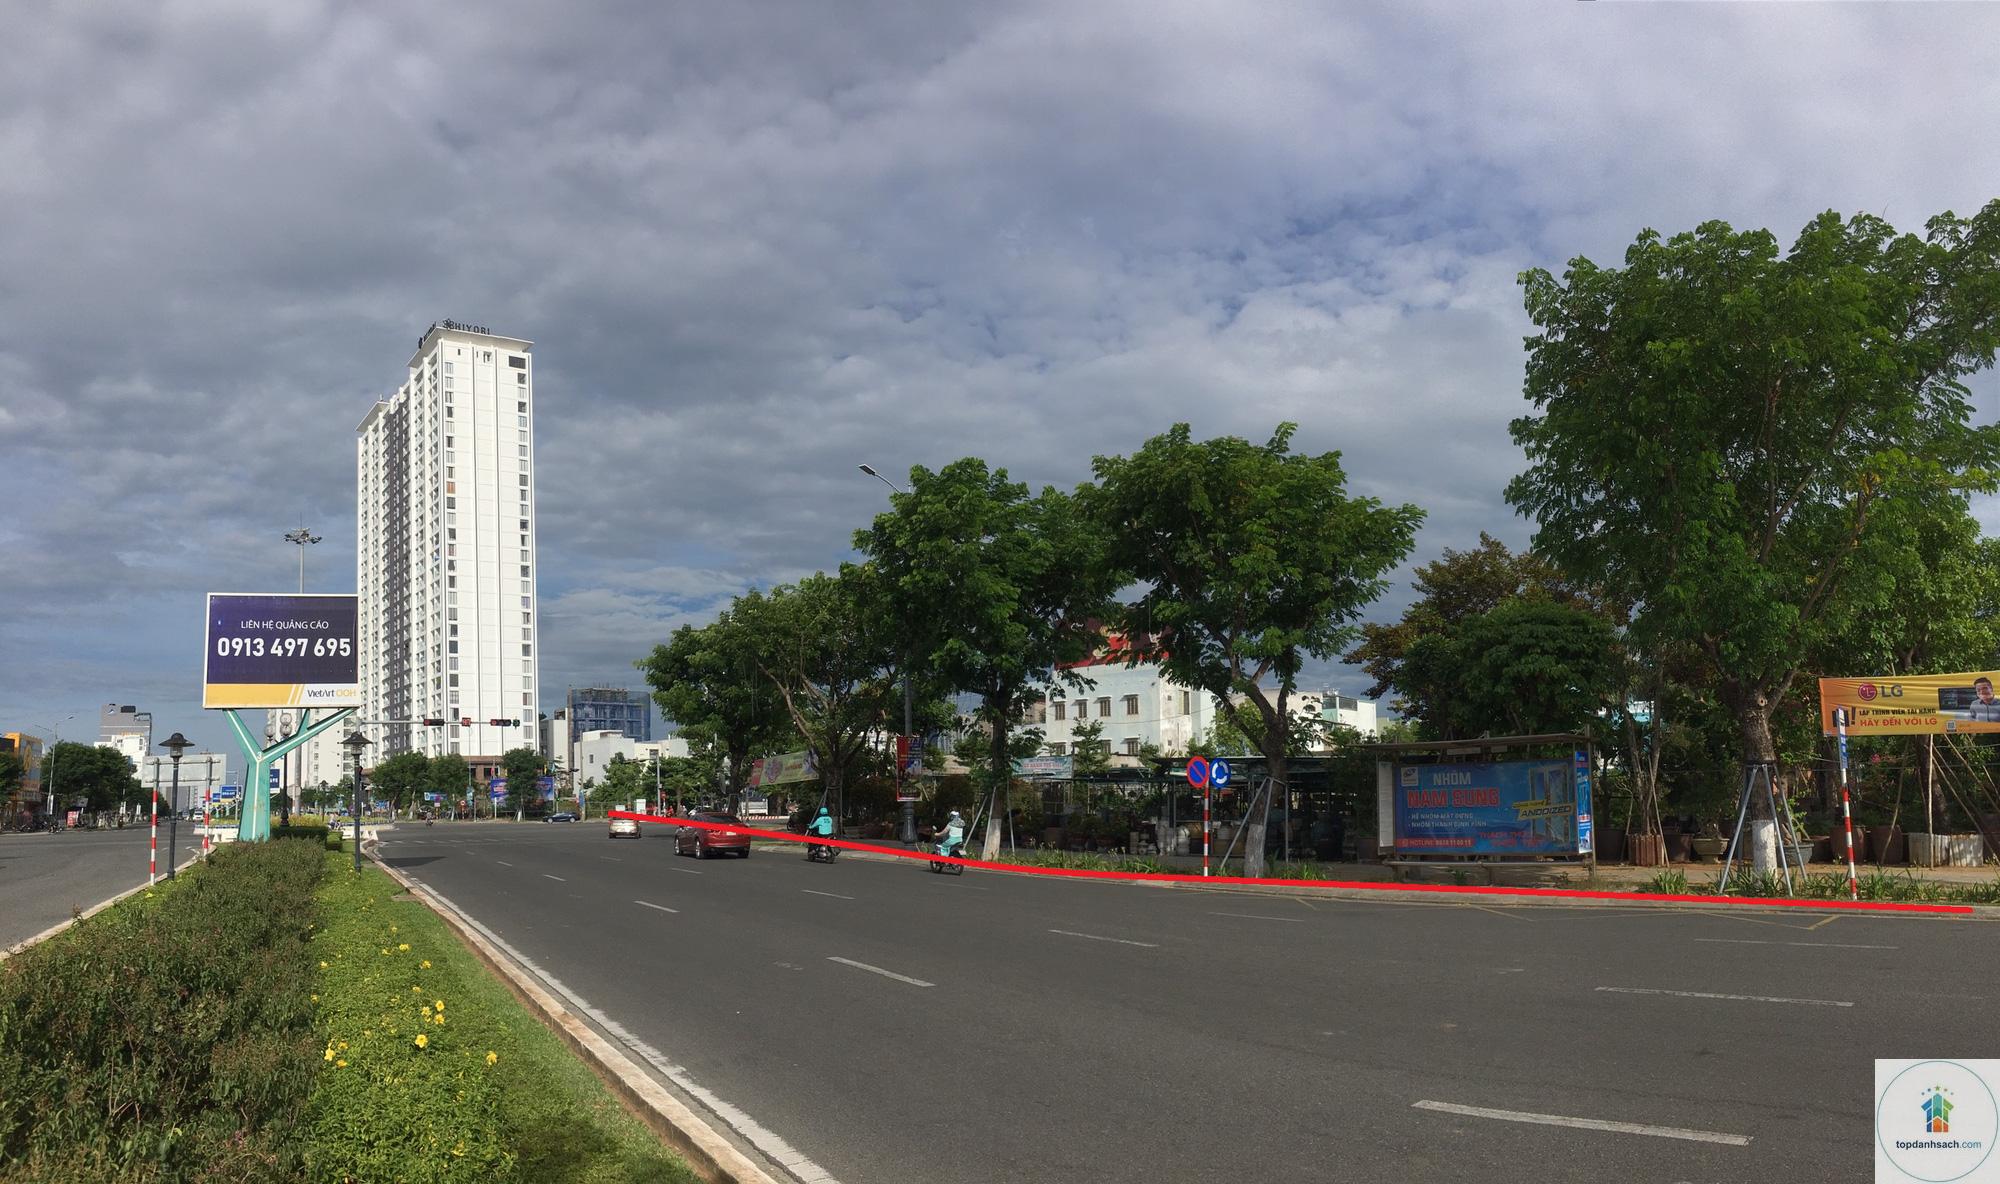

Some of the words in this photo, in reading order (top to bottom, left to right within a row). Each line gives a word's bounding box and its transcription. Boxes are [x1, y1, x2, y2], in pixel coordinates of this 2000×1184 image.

[240, 620, 260, 629] LIÊN
[261, 620, 274, 630] HỆ
[275, 619, 308, 630] QUẢNG
[309, 620, 330, 629] CÁO
[217, 637, 265, 657] 0913
[270, 638, 308, 657] 497
[313, 638, 351, 657] 695
[1881, 685, 1904, 698] LG
[1860, 718, 1879, 726] HÃY
[1882, 715, 1902, 726] ĐẾN
[1904, 716, 1922, 726] VỚI
[1925, 717, 1938, 725] LG
[1407, 789, 1448, 808] NAM
[1452, 786, 1500, 808] SUNG
